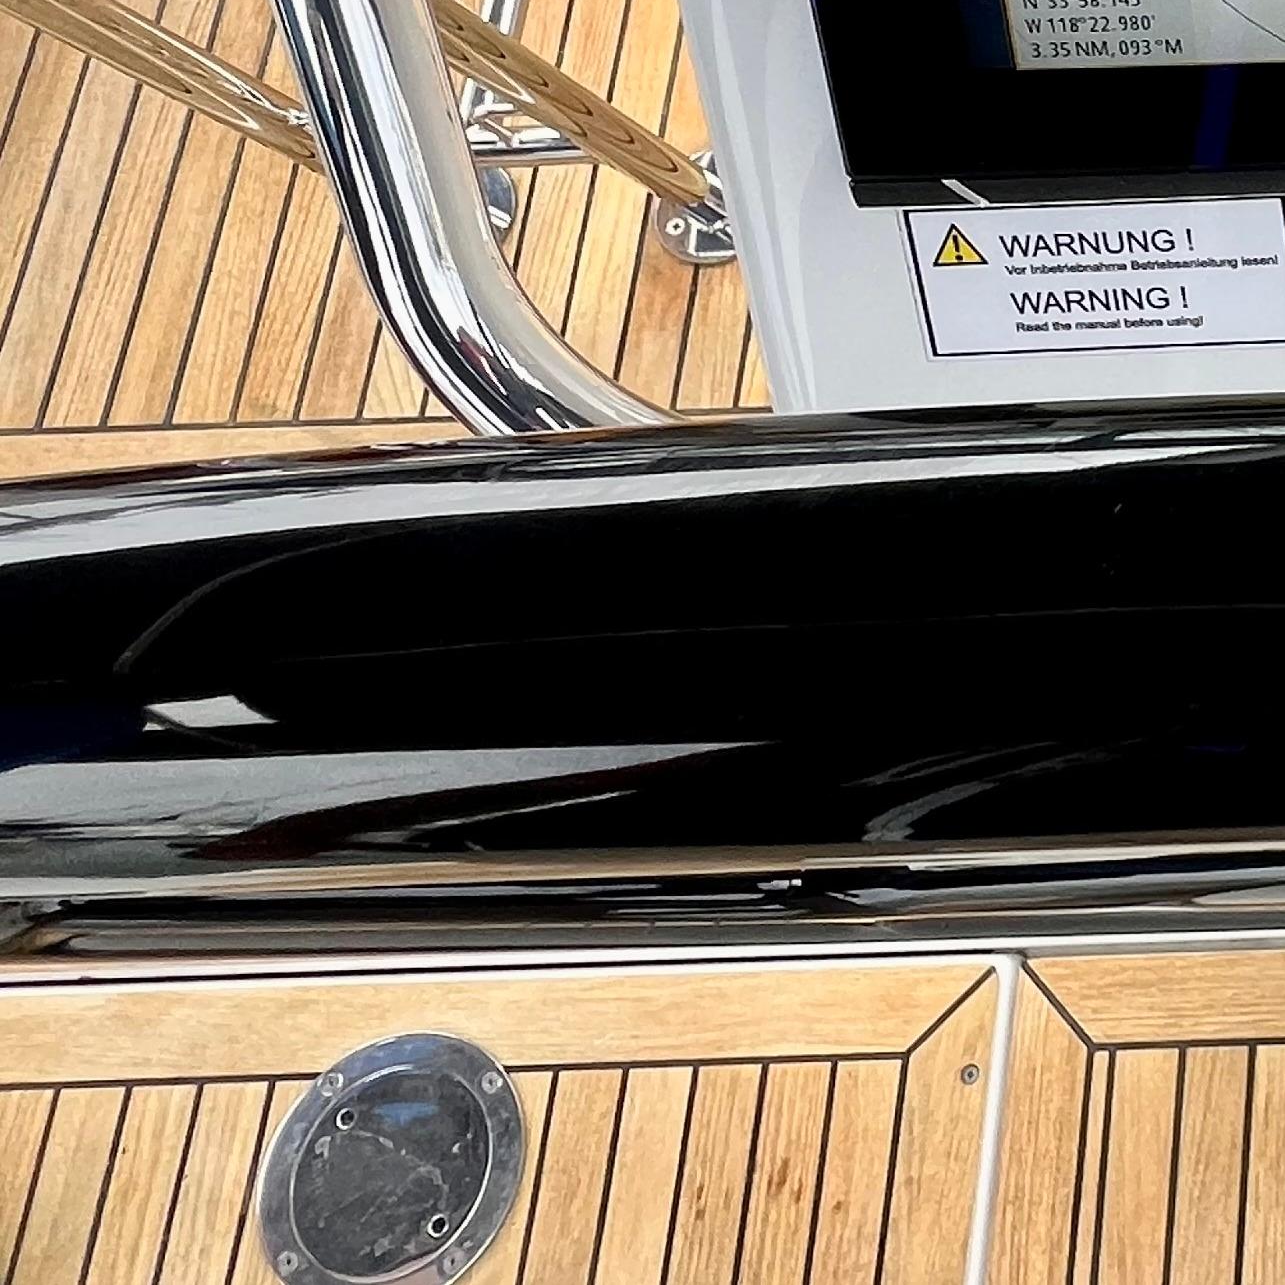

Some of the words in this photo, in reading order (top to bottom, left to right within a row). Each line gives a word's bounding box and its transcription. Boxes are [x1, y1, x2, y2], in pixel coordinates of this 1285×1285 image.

[1024, 18, 1041, 33] W
[1031, 42, 1071, 58] 3.35
[1118, 39, 1151, 56] 093
[999, 229, 1176, 257] WARNUNG
[1010, 287, 1170, 314] WARNING
